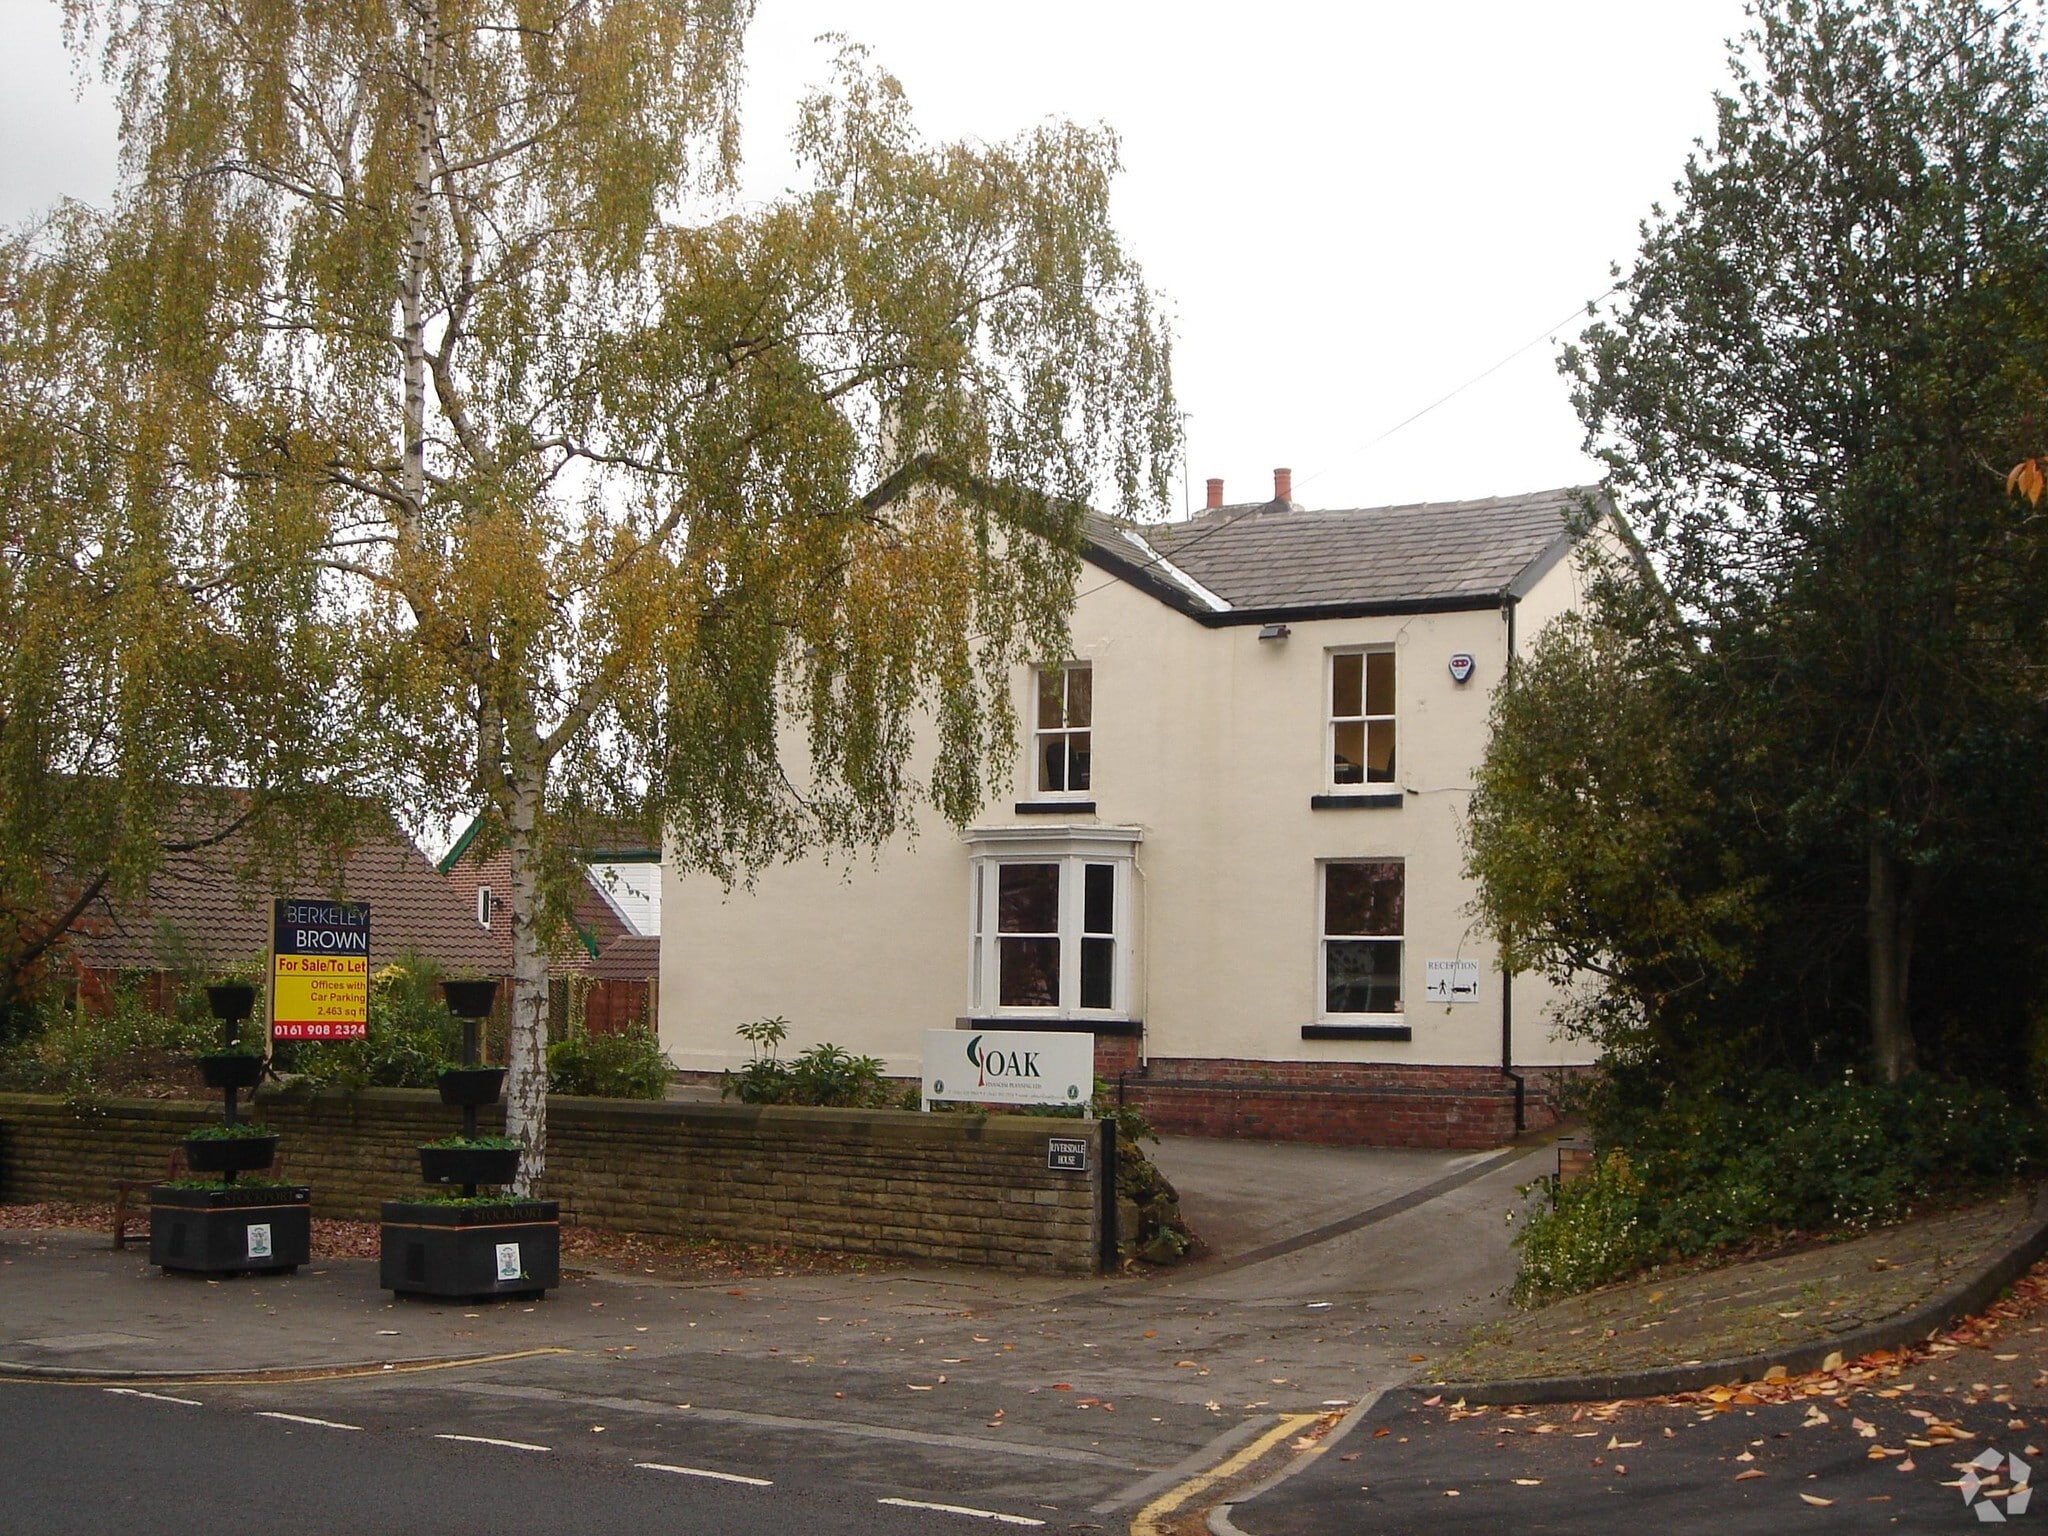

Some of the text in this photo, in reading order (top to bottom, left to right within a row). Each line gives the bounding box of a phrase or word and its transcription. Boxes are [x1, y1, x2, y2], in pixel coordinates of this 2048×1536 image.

[287, 905, 368, 926] BERKELEY
[296, 929, 366, 950] BROWN
[279, 958, 366, 973] For Sale/To Let
[1428, 961, 1478, 970] RECEPTION
[311, 980, 366, 990] Offices with
[310, 992, 366, 1005] Car Parking
[317, 1006, 366, 1018] 2,463 sq ft
[274, 1024, 366, 1036] 0161 908 2324
[985, 1050, 1041, 1078] OAK
[1050, 1143, 1085, 1154] RIVERSDALE
[1057, 1155, 1076, 1165] HOUSE
